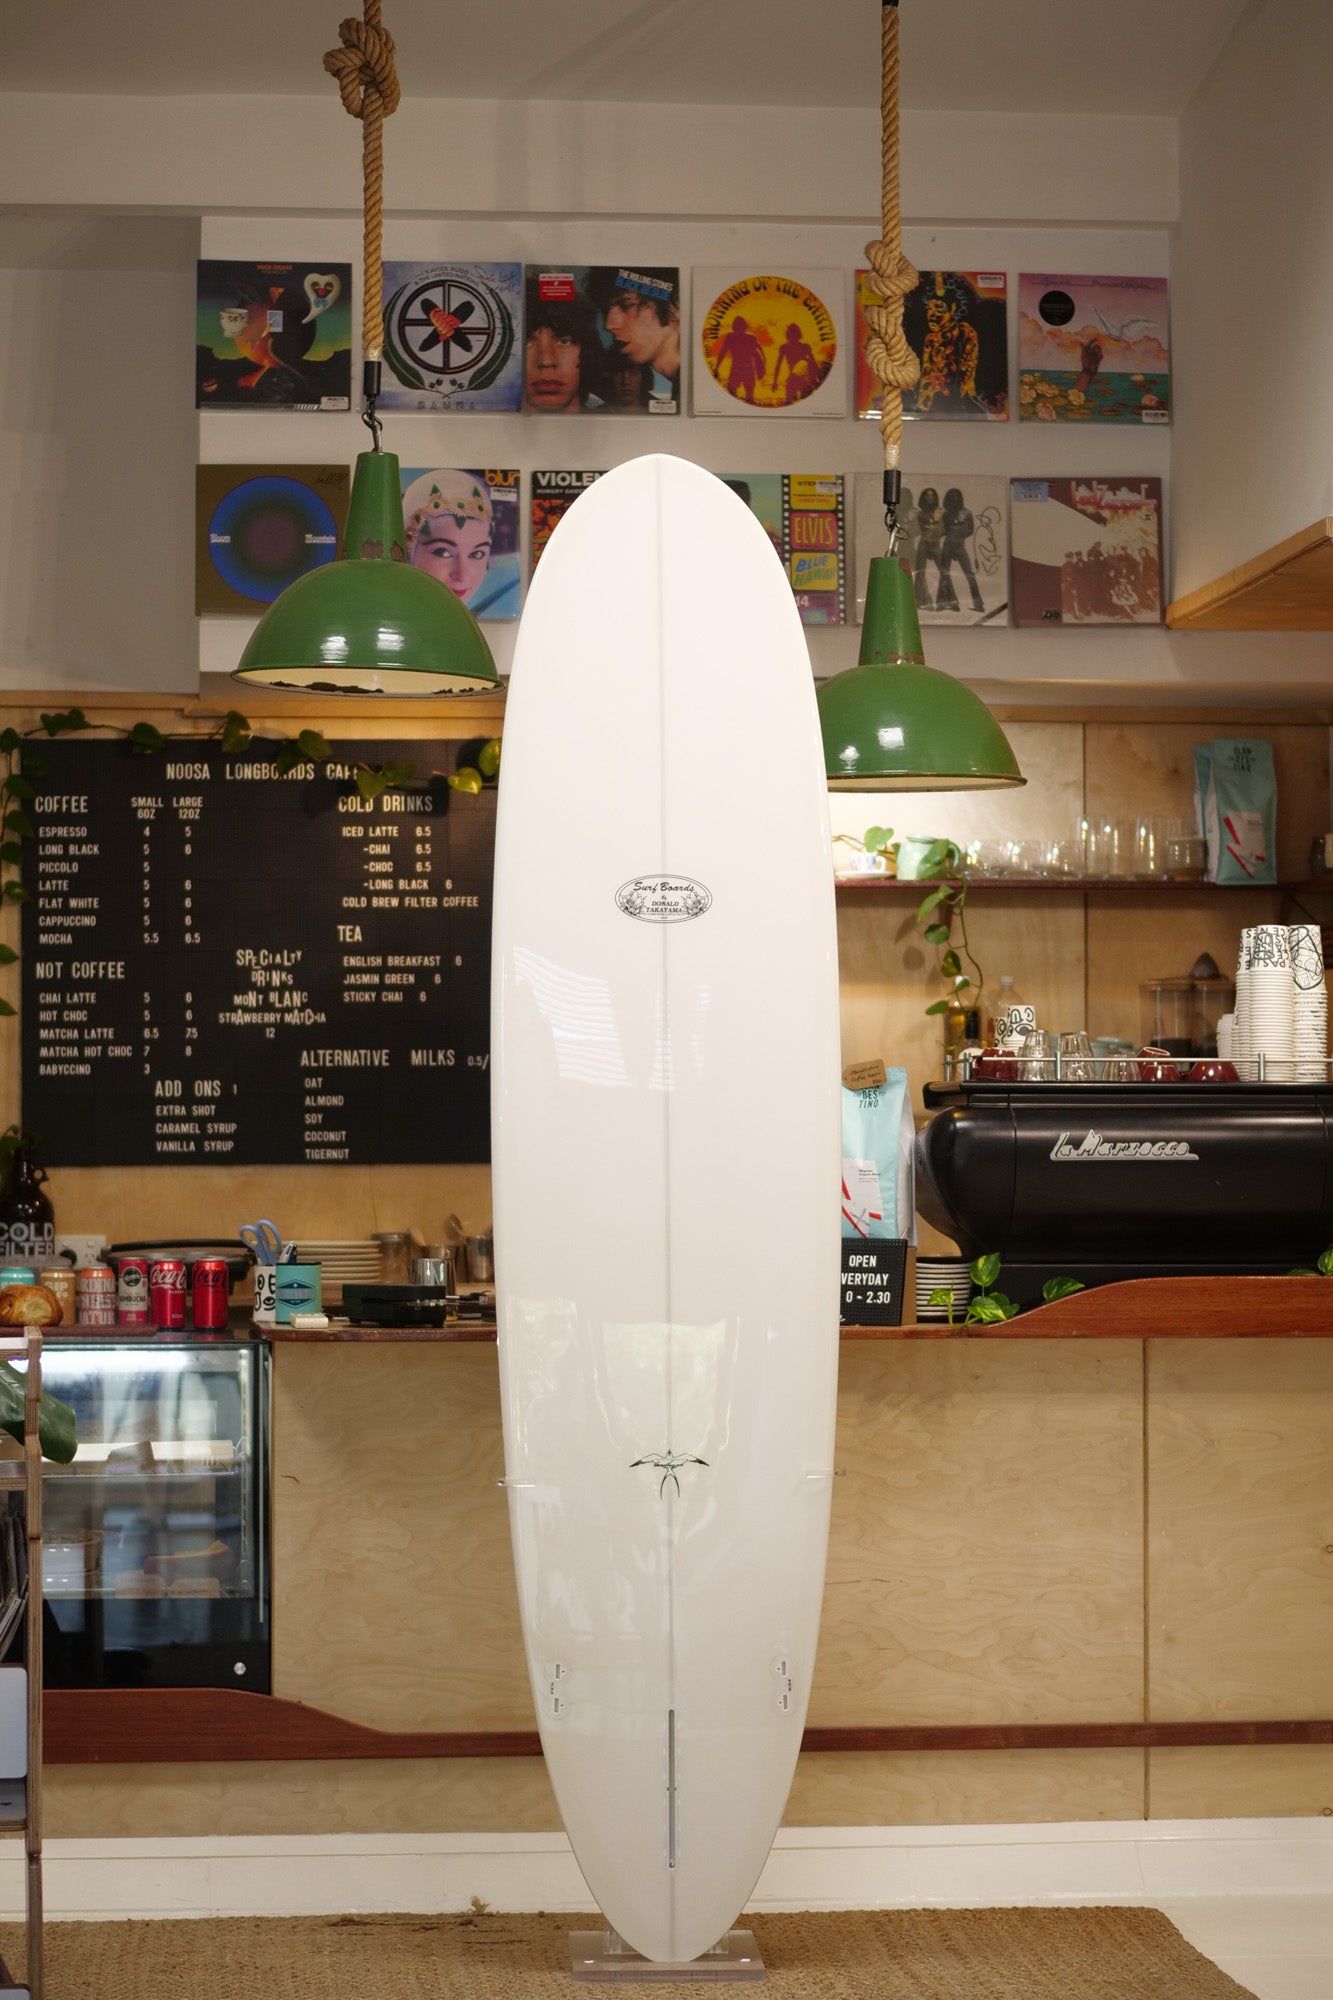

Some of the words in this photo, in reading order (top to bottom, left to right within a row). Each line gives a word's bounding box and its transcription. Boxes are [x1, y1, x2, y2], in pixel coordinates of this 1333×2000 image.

[707, 281, 750, 340] MORNING
[752, 276, 770, 292] OF
[776, 278, 803, 299] THE
[802, 290, 835, 342] EARTH
[485, 469, 520, 486] blur
[794, 517, 834, 545] ELVIS
[210, 533, 231, 543] Bloom
[794, 555, 828, 573] BLUE
[166, 763, 211, 780] NOOSA
[226, 763, 315, 781] LONGBORDS
[35, 796, 89, 813] COFFEE
[131, 797, 164, 808] SMALL
[172, 797, 204, 808] LARGE
[338, 796, 374, 813] COLD
[383, 796, 433, 813] DRINKS
[39, 826, 88, 838] ESPRESSO
[144, 826, 151, 838] 4
[185, 826, 192, 837] 5
[342, 826, 364, 837] ICED
[369, 826, 399, 837] LATTE
[416, 826, 432, 837] 6.5
[39, 845, 64, 855] LONG
[69, 845, 100, 855] BLACK
[144, 844, 151, 855] 5
[185, 844, 192, 855] 6
[363, 844, 391, 855] -CHAI
[416, 844, 432, 855] 6.5
[39, 862, 79, 873] PICCOLO
[144, 862, 151, 873] 5
[363, 862, 394, 872] -CHOC
[416, 862, 432, 872] 6.5
[39, 880, 69, 891] LATTE
[144, 880, 151, 891] 5
[185, 880, 192, 891] 6
[363, 879, 394, 890] -LONG
[398, 879, 429, 890] BLACK
[445, 879, 453, 890] 6
[633, 881, 659, 894] Surf
[660, 882, 695, 892] Boards
[39, 898, 63, 909] FLAT
[69, 898, 100, 909] WHITE
[144, 898, 151, 909] 5
[185, 898, 192, 909] 6
[342, 897, 367, 908] COLD
[372, 897, 400, 908] BREW
[404, 896, 438, 908] FILTER
[443, 896, 479, 907] COFFEE
[39, 916, 97, 927] CAPPUCCINO
[144, 916, 151, 926] 5
[185, 916, 192, 926] 6
[39, 934, 73, 944] MOCHA
[144, 934, 159, 944] 5.5
[185, 934, 201, 944] 6.5
[337, 925, 363, 942] TEA
[236, 949, 302, 969] SPECIALTY
[343, 956, 383, 967] ENGLISH
[388, 956, 442, 967] BREAKFAST
[455, 956, 462, 967] 6
[36, 962, 63, 979] NOT
[72, 962, 125, 979] COFFEE
[251, 970, 294, 987] DRINKS
[343, 974, 380, 985] JASMIN
[384, 974, 415, 985] GREEN
[434, 974, 442, 985] 6
[39, 992, 61, 1003] CHAI
[66, 992, 97, 1003] LATTE
[144, 992, 151, 1003] 5
[186, 992, 192, 1003] 6
[233, 991, 264, 1008] MONT
[269, 991, 308, 1008] BLANC
[343, 992, 377, 1002] STICKY
[381, 992, 403, 1002] CHAI
[420, 992, 427, 1002] 6
[40, 1010, 58, 1021] HOT
[64, 1010, 88, 1021] CHOC
[144, 1010, 151, 1021] 5
[186, 1010, 192, 1021] 6
[219, 1010, 282, 1025] STRAWBERRY
[40, 1028, 79, 1039] MATCHA
[84, 1028, 115, 1039] LATTE
[144, 1028, 159, 1039] 6.5
[266, 1027, 276, 1038] 12
[40, 1046, 79, 1057] MATCHA
[84, 1046, 102, 1057] HOT
[108, 1046, 133, 1057] CHOC
[144, 1046, 150, 1056] 7
[301, 1050, 390, 1067] ALTERNATIVE
[411, 1050, 456, 1066] MILKS
[39, 1064, 91, 1075] BABYCCINO
[144, 1064, 151, 1075] 3
[155, 1080, 182, 1097] ADD
[194, 1080, 221, 1097] ONS
[304, 1078, 324, 1088] OAT
[862, 1090, 879, 1100] DES
[304, 1096, 345, 1106] ALMOND
[860, 1100, 879, 1109] TINO
[156, 1105, 187, 1116] EXTRA
[192, 1105, 216, 1116] SHOT
[305, 1113, 324, 1124] SOY
[156, 1123, 201, 1134] CARAMEL
[207, 1123, 238, 1134] SYRUP
[305, 1131, 347, 1142] COCONUT
[156, 1141, 196, 1152] VANILLA
[204, 1141, 234, 1152] SYRUP
[1076, 1129, 1190, 1158] Marzocco
[305, 1148, 350, 1160] TIGERNUT
[0, 1222, 54, 1242] COLD
[849, 1255, 877, 1267] OPEN
[866, 1291, 891, 1304] 2.30
